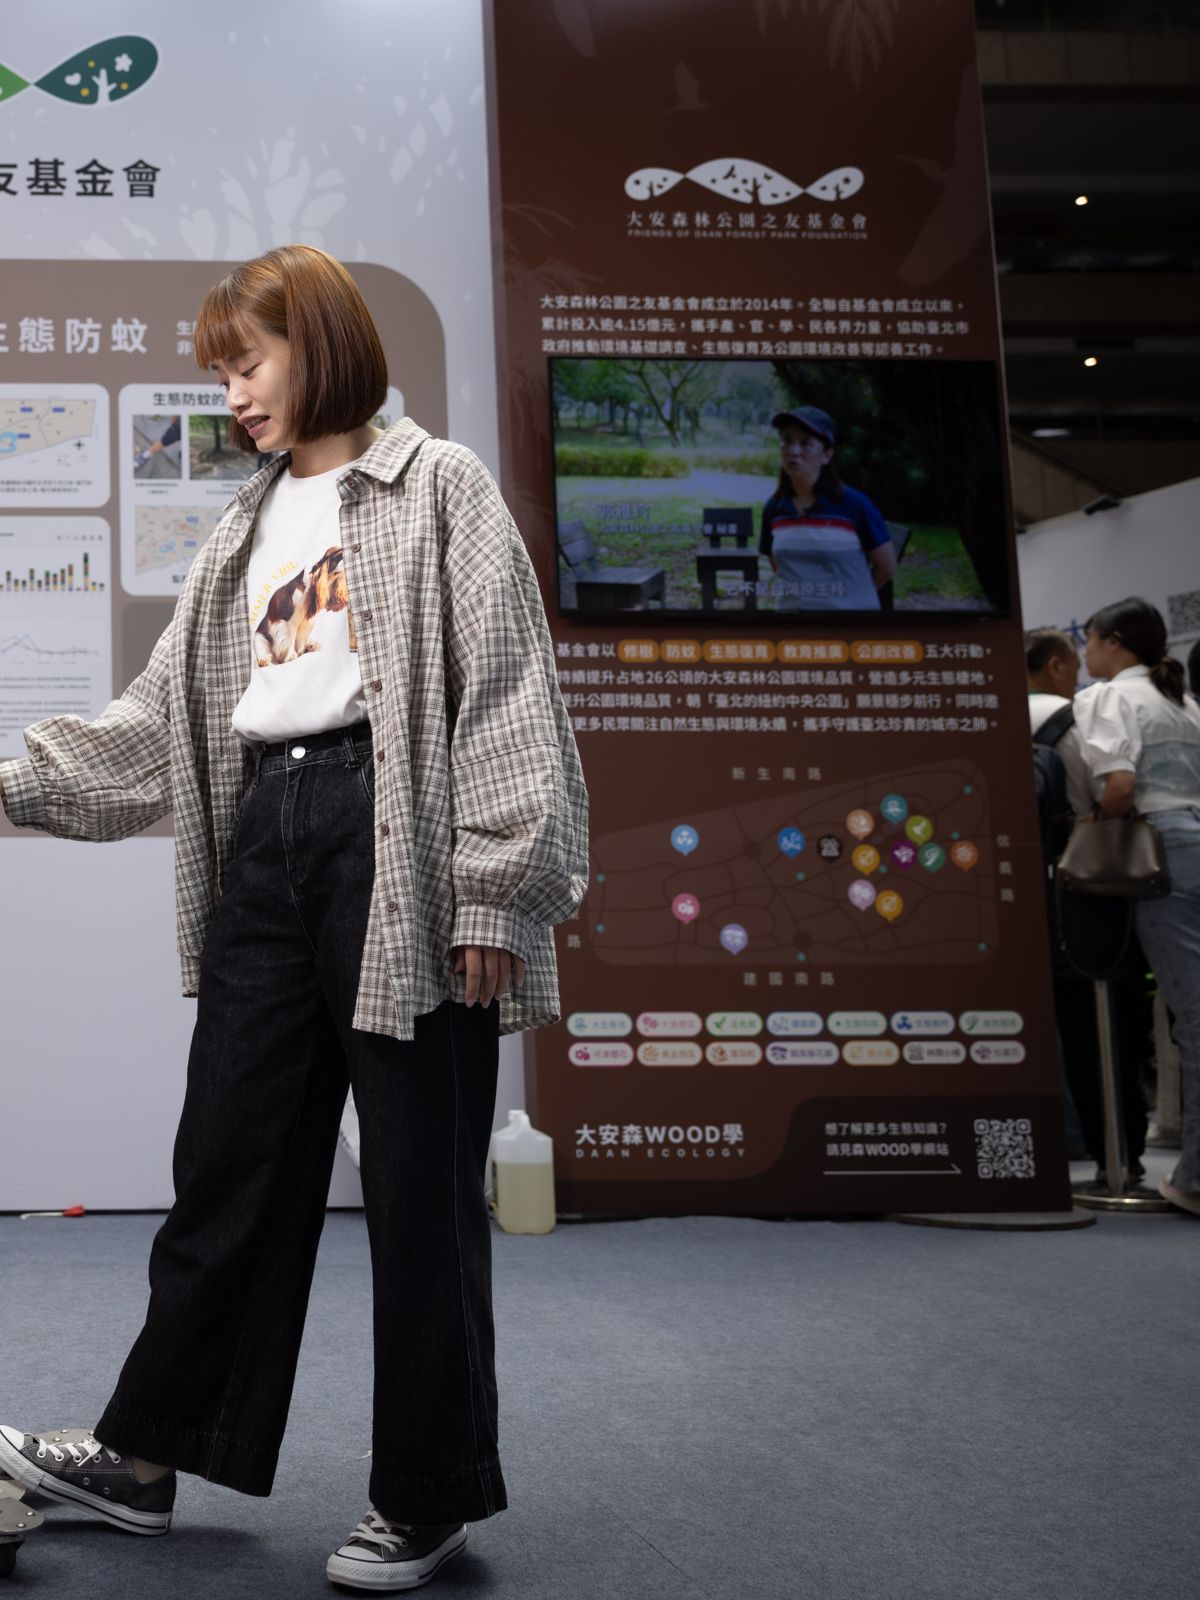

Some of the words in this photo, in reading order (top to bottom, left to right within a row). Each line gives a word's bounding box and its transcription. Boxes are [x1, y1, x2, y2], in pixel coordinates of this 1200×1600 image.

[626, 210, 867, 230] 大安森林公園之友基金會
[575, 1123, 745, 1146] 大安森WOOD學
[576, 1148, 631, 1158] DAAN
[648, 1148, 746, 1158] ECOLOGY
